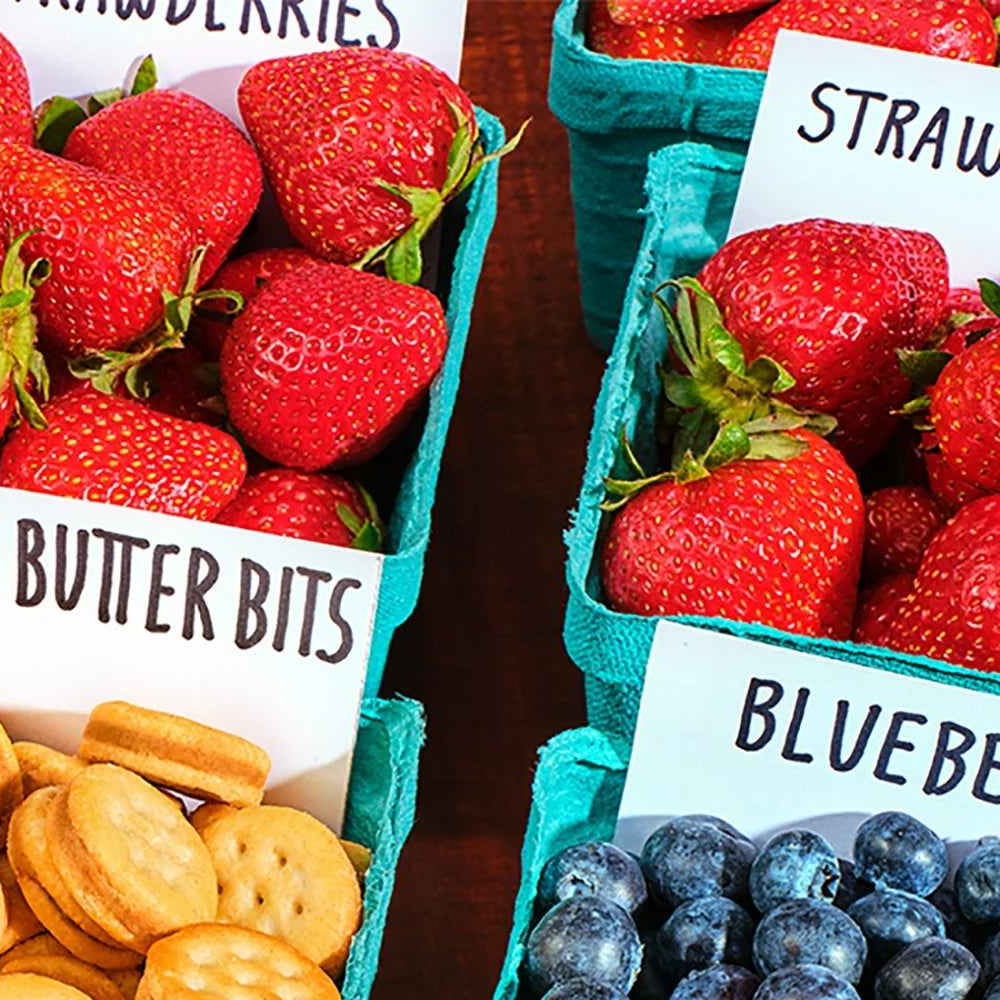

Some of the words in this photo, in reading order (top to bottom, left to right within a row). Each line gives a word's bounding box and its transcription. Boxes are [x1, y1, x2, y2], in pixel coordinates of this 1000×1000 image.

[797, 82, 1000, 178] STRAW
[15, 518, 220, 641] BUTTER
[234, 557, 362, 665] BITS
